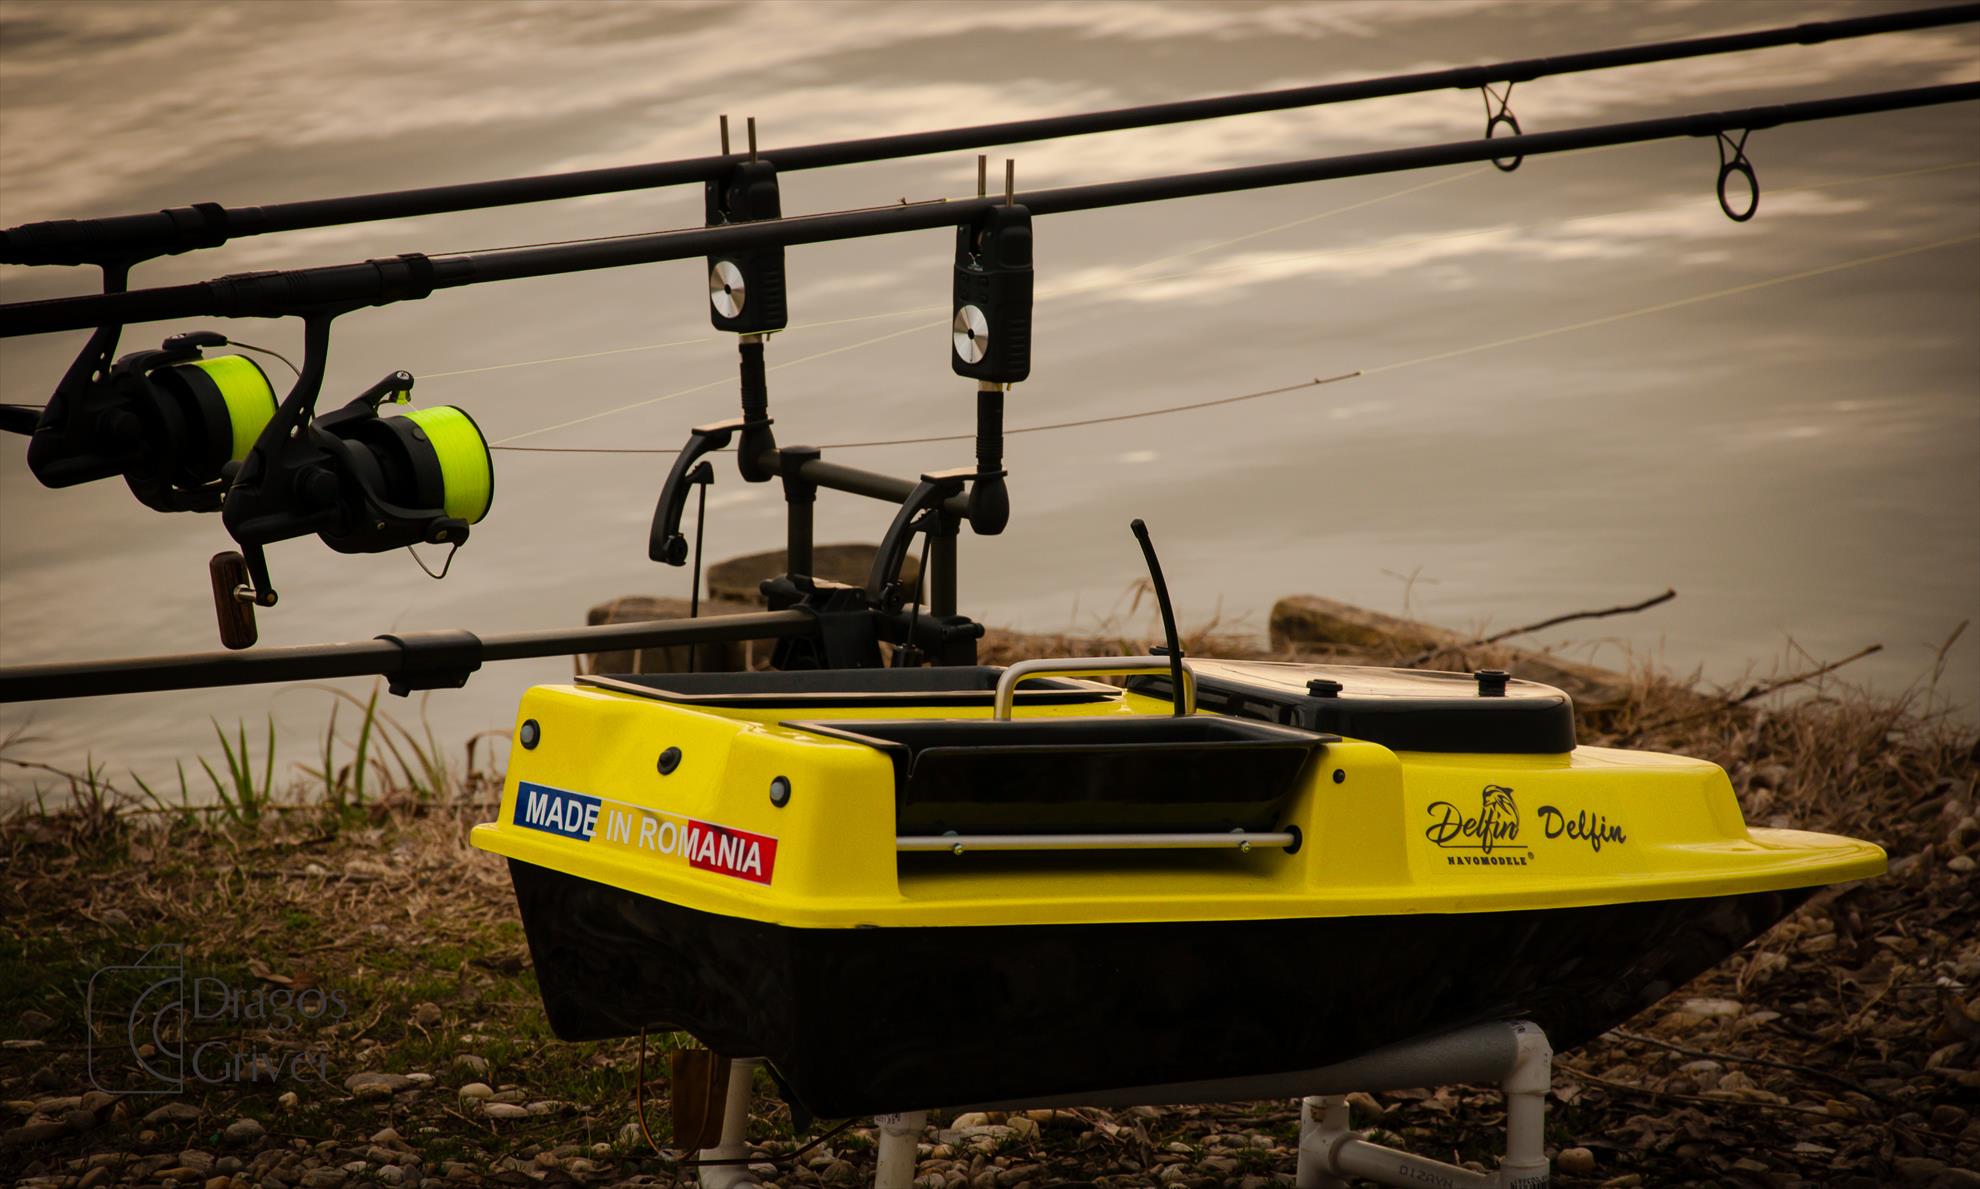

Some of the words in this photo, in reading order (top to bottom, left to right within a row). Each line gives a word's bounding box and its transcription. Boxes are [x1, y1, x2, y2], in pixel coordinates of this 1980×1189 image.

[525, 791, 601, 837] MADE
[606, 809, 633, 845] IN
[638, 815, 762, 876] ROMANIA
[1425, 801, 1519, 854] Delfin
[1537, 805, 1627, 853] Delfin
